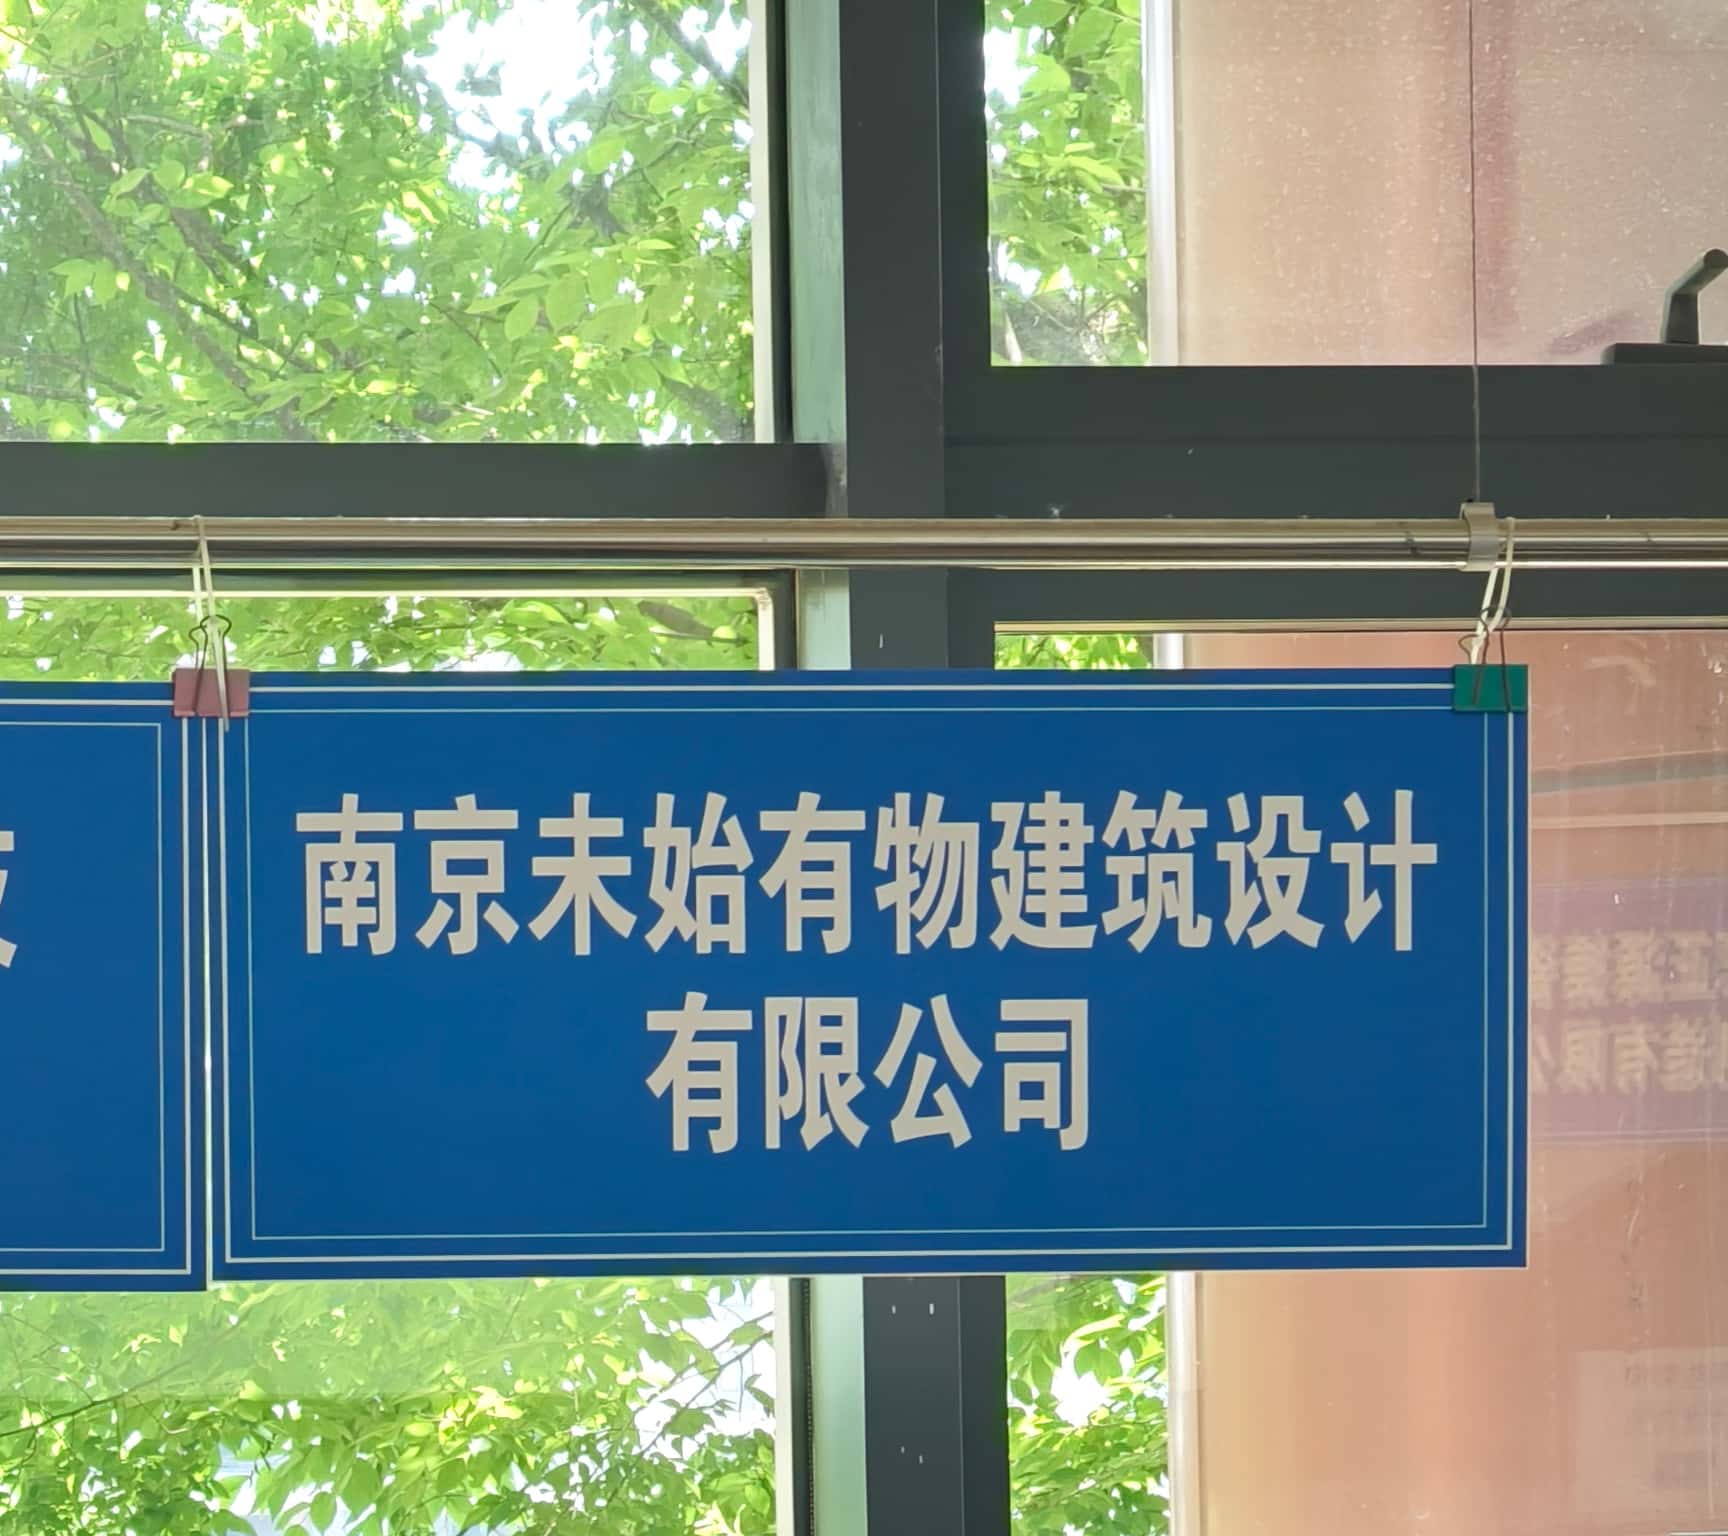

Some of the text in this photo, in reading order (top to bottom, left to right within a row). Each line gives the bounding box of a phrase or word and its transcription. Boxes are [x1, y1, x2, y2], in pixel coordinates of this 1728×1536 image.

[295, 789, 1439, 957] 南京未始有物建筑设计
[644, 991, 1091, 1154] 有限公司
